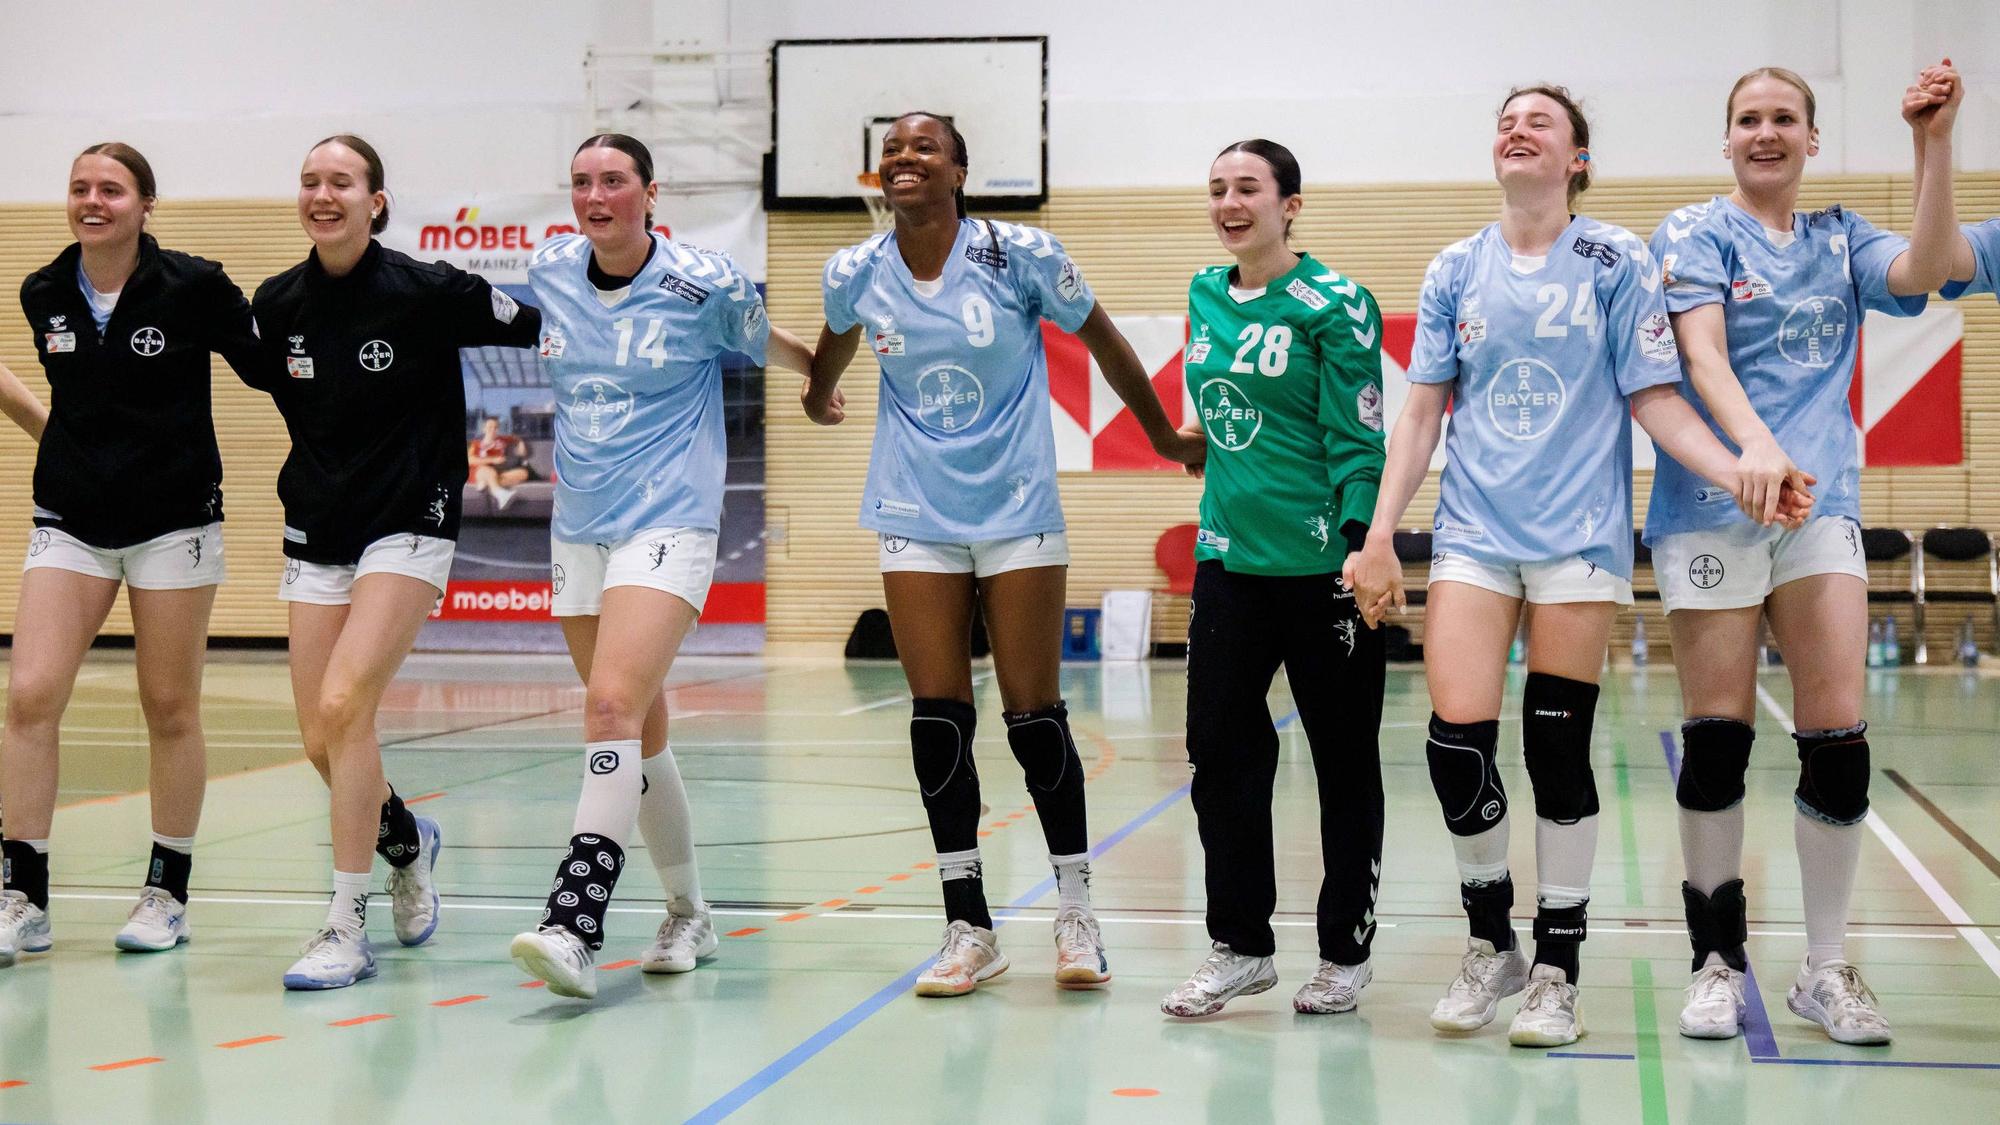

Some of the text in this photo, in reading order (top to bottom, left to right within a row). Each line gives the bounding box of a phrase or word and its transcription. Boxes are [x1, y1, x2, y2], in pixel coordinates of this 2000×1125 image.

[963, 297, 995, 347] 9
[1534, 281, 1598, 338] 24
[134, 337, 162, 346] BAYER
[362, 351, 391, 360] BAYER
[612, 317, 668, 369] 14
[1229, 322, 1293, 378] 28
[924, 391, 978, 406] BAYER
[938, 372, 955, 428] BAYER
[1204, 408, 1257, 421] BAYER
[1218, 385, 1238, 446] BAYER
[1494, 392, 1560, 406] BAYER
[1518, 365, 1531, 434] BAYER
